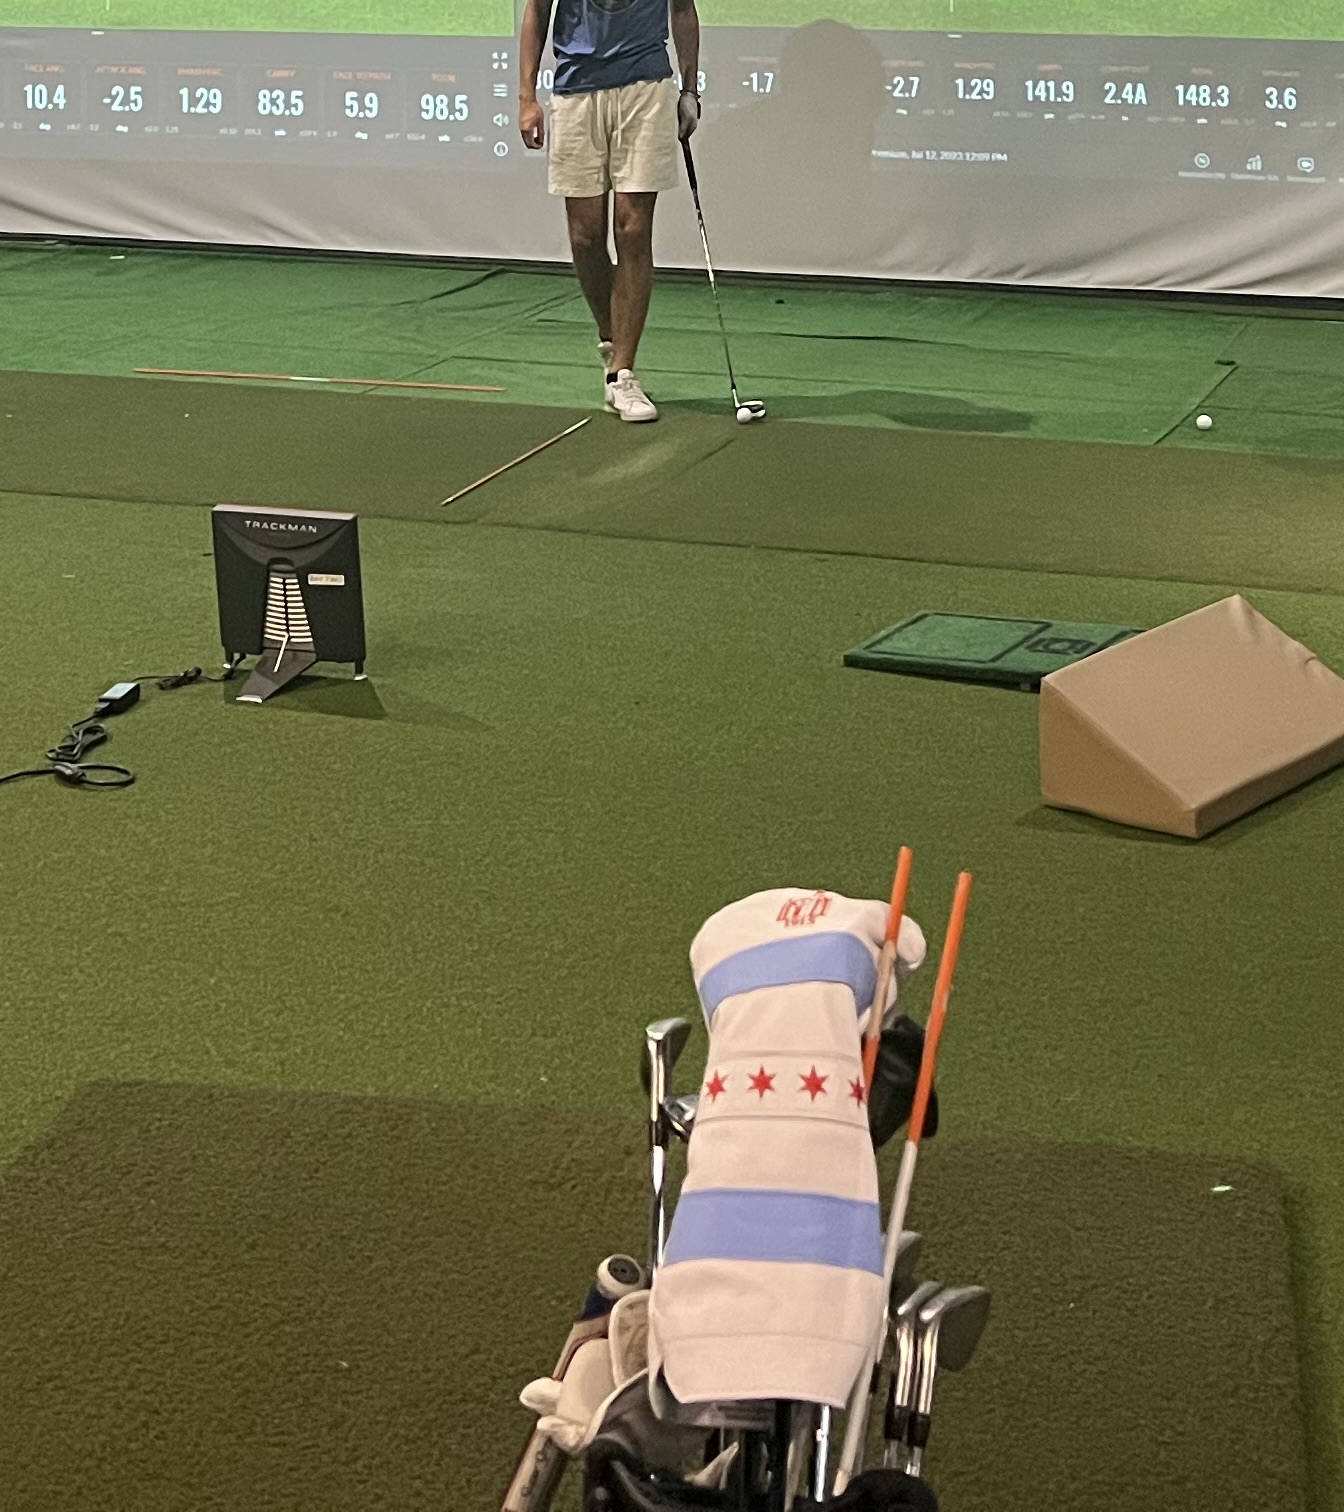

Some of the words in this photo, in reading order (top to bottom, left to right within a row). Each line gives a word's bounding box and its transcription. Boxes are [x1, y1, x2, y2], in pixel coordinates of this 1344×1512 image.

[24, 84, 66, 110] 10.4
[102, 85, 143, 112] -2.5
[179, 87, 222, 114] 1.29
[258, 89, 304, 116] 83.5
[345, 91, 379, 118] 5.9
[420, 94, 469, 121] 98.5
[742, 71, 775, 94] -1.7
[884, 76, 920, 99] -2.7
[955, 78, 995, 101] 1.29
[1024, 80, 1074, 103] 141.9
[1104, 82, 1148, 106] 2.4A
[1175, 84, 1230, 108] 148.3
[1264, 87, 1298, 110] 3.6
[244, 520, 318, 533] TRACKMAN
